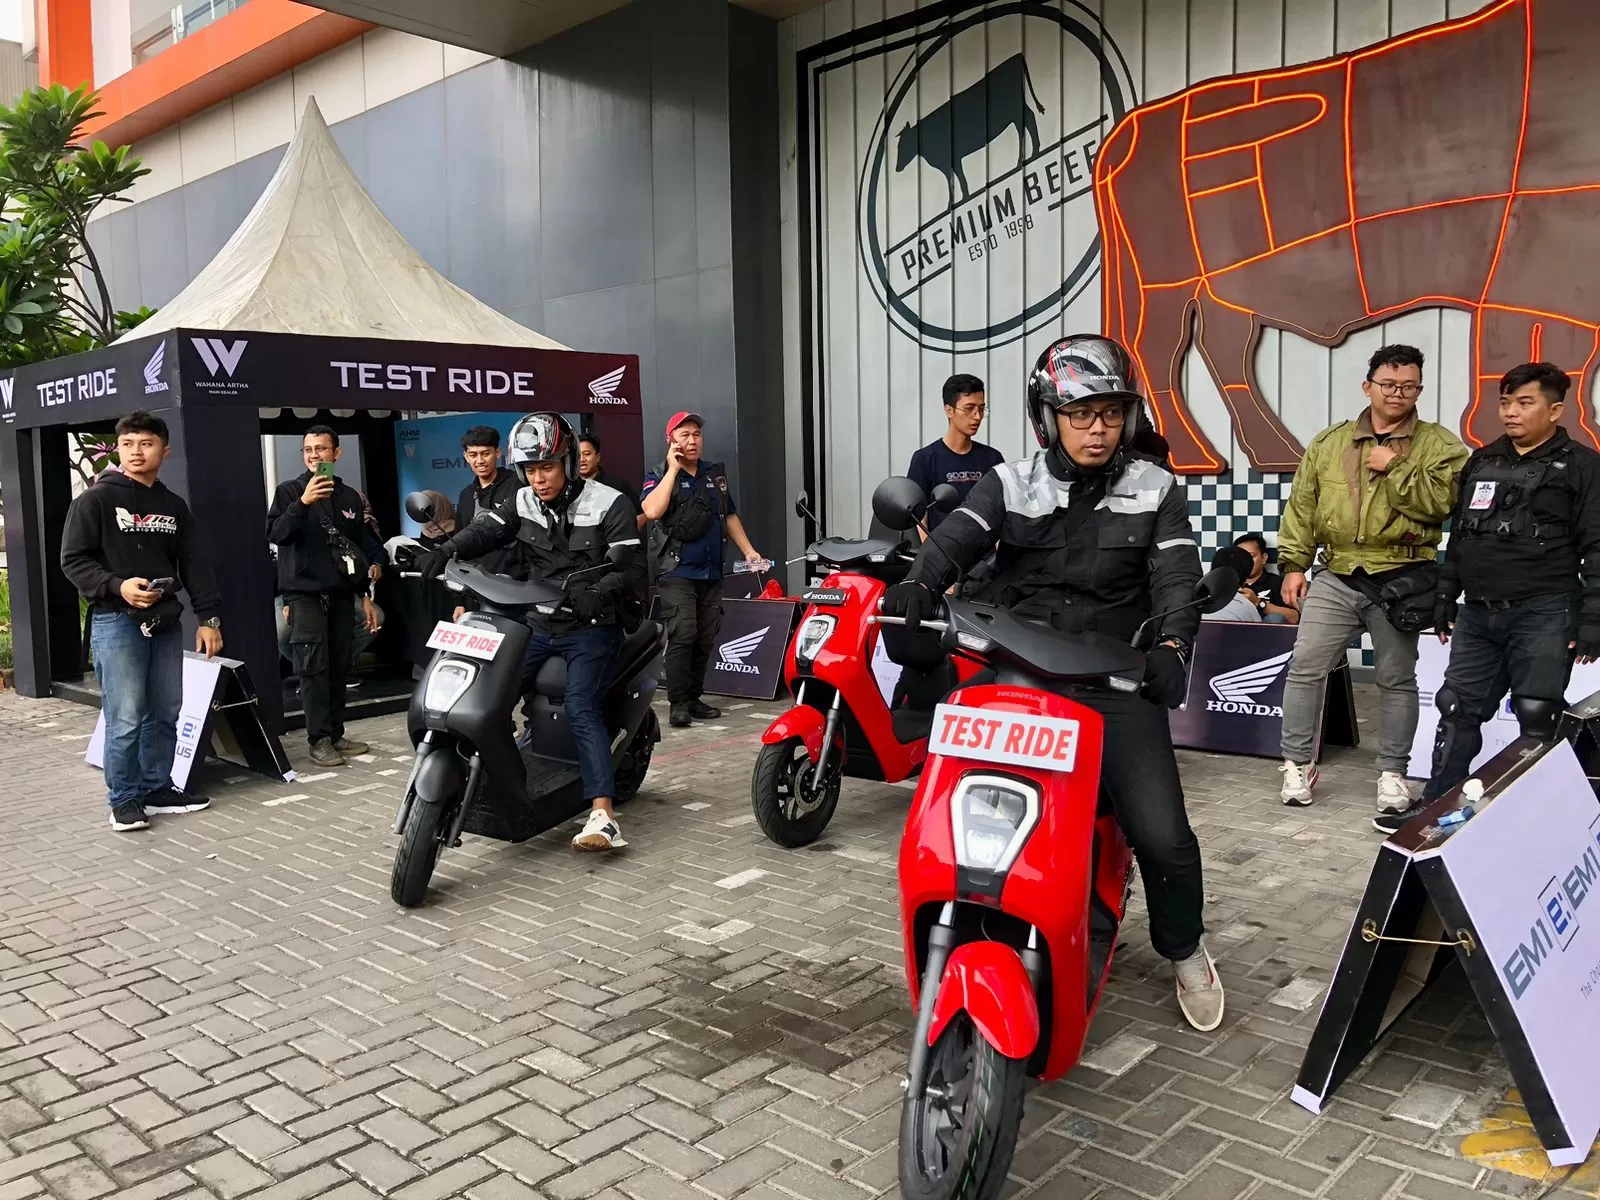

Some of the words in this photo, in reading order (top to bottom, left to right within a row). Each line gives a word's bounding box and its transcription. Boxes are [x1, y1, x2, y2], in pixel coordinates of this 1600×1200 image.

[900, 187, 1016, 280] PREMIUM
[1023, 139, 1098, 206] BEEF
[968, 233, 998, 261] ESTD
[1004, 213, 1034, 240] 1998
[36, 377, 74, 407] TEST
[77, 367, 117, 400] RIDE
[144, 381, 169, 394] HONDA
[227, 381, 249, 389] ARTHA
[330, 361, 437, 391] TEST
[448, 368, 535, 396] RIDE
[588, 397, 629, 405] HONDA
[811, 593, 840, 601] HONDA
[434, 628, 468, 646] TEST
[466, 636, 498, 653] RIDE
[714, 661, 760, 675] HONDA
[1206, 700, 1284, 717] HONDA
[940, 713, 1002, 750] TEST
[1003, 723, 1073, 760] RIDE
[1503, 917, 1554, 1000] EM1
